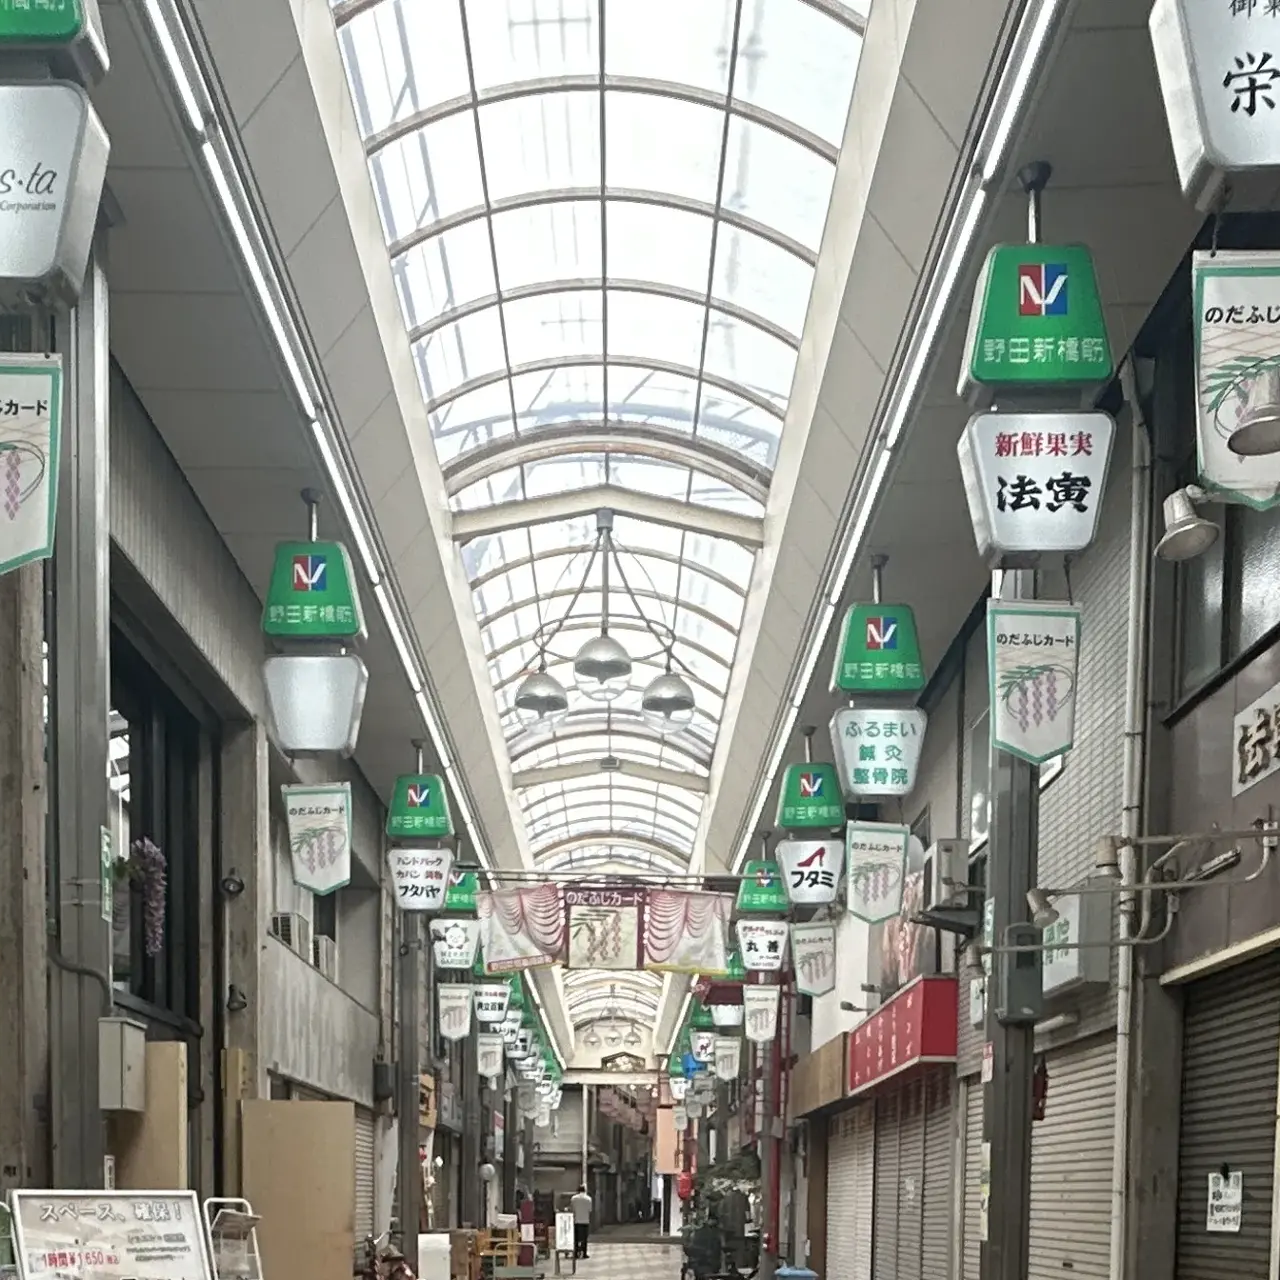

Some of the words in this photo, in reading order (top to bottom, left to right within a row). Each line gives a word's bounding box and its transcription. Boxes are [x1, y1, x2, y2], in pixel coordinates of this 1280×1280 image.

[0, 200, 56, 214] Corporation
[983, 336, 1105, 363] 野田新橋筋
[994, 430, 1093, 457] 新鮮果実
[996, 471, 1092, 513] 法寅
[996, 632, 1074, 648] のだふじカード
[845, 721, 917, 738] ふるまい
[852, 767, 908, 785] 整骨院
[288, 804, 345, 816] のだふじカード
[791, 870, 835, 889] フタミ
[566, 890, 643, 906] のだふじカード
